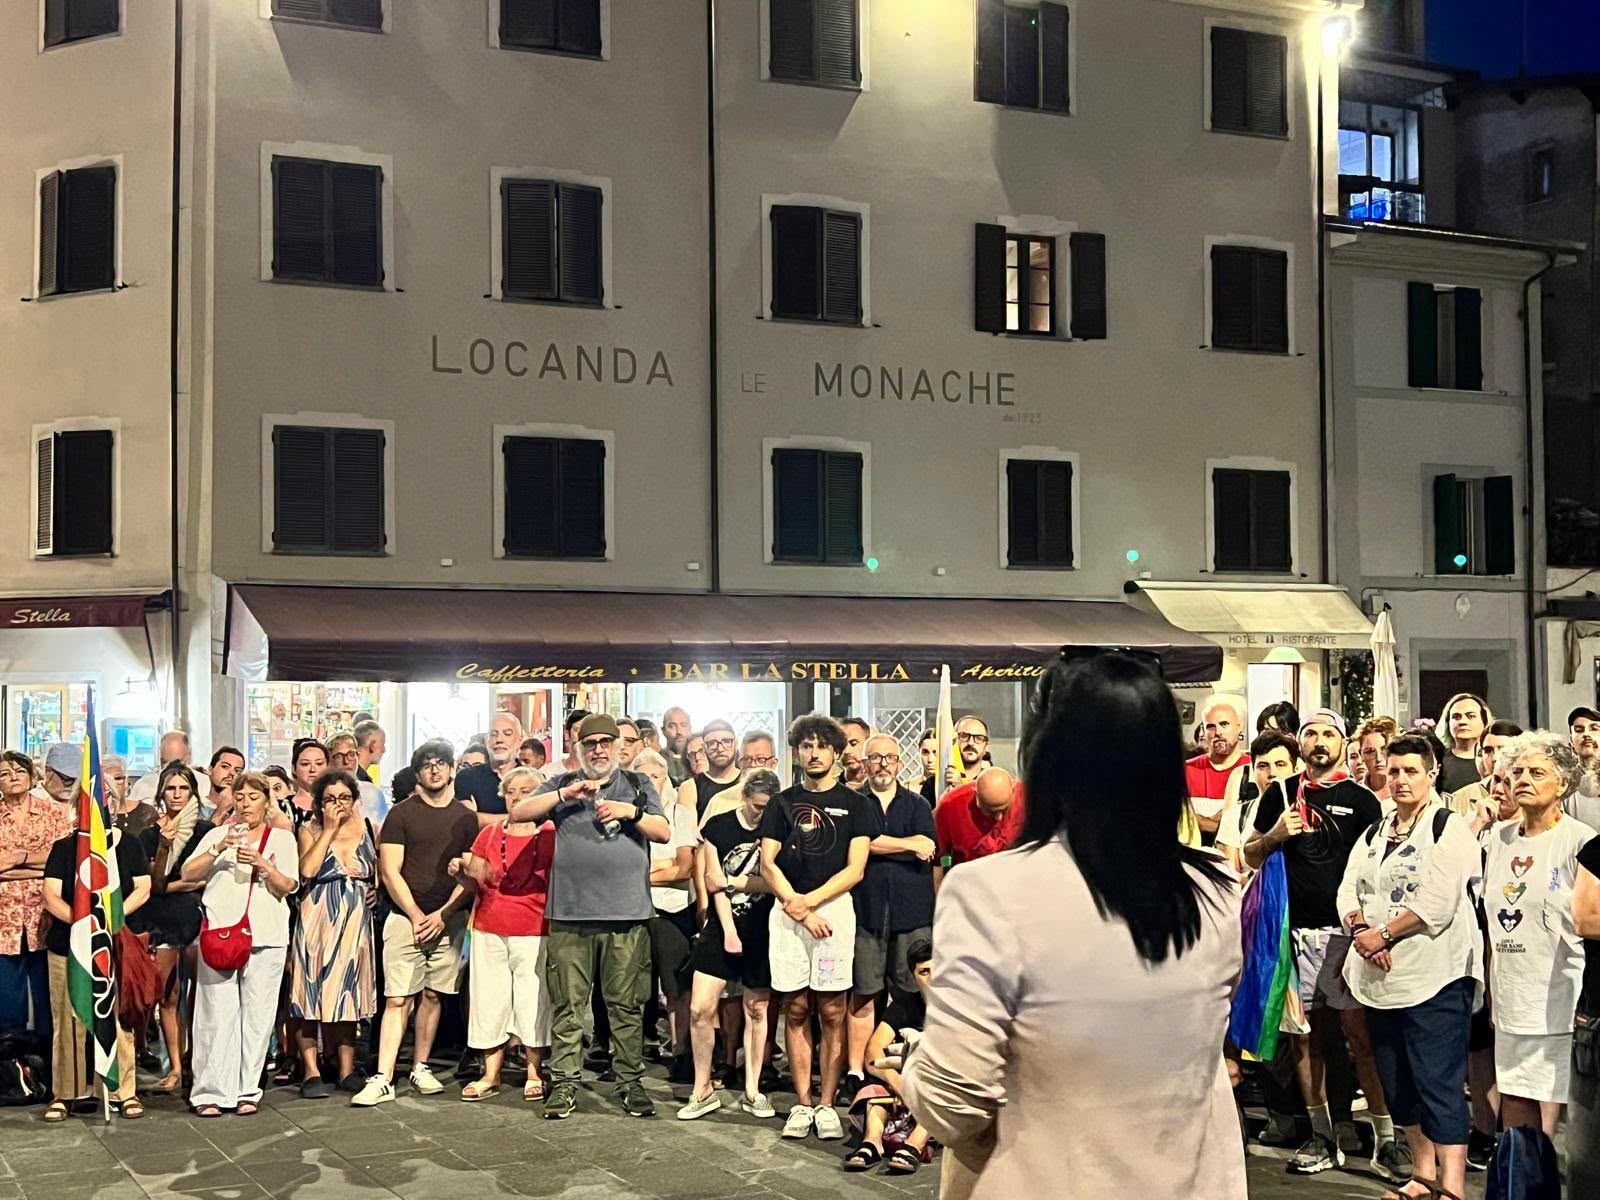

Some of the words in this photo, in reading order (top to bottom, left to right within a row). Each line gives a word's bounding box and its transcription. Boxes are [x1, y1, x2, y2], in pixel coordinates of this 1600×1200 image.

[433, 335, 674, 386] LOCANDA
[741, 371, 767, 393] LE
[815, 362, 1016, 406] MONACHE
[10, 608, 71, 624] Stella
[1229, 635, 1258, 644] HOTEL
[1282, 636, 1337, 645] RISTORANTE
[455, 663, 606, 682] Caffetteria
[663, 663, 731, 681] BAR
[741, 663, 784, 681] LA
[791, 662, 910, 681] STELLA
[961, 664, 1046, 682] Aperiti
